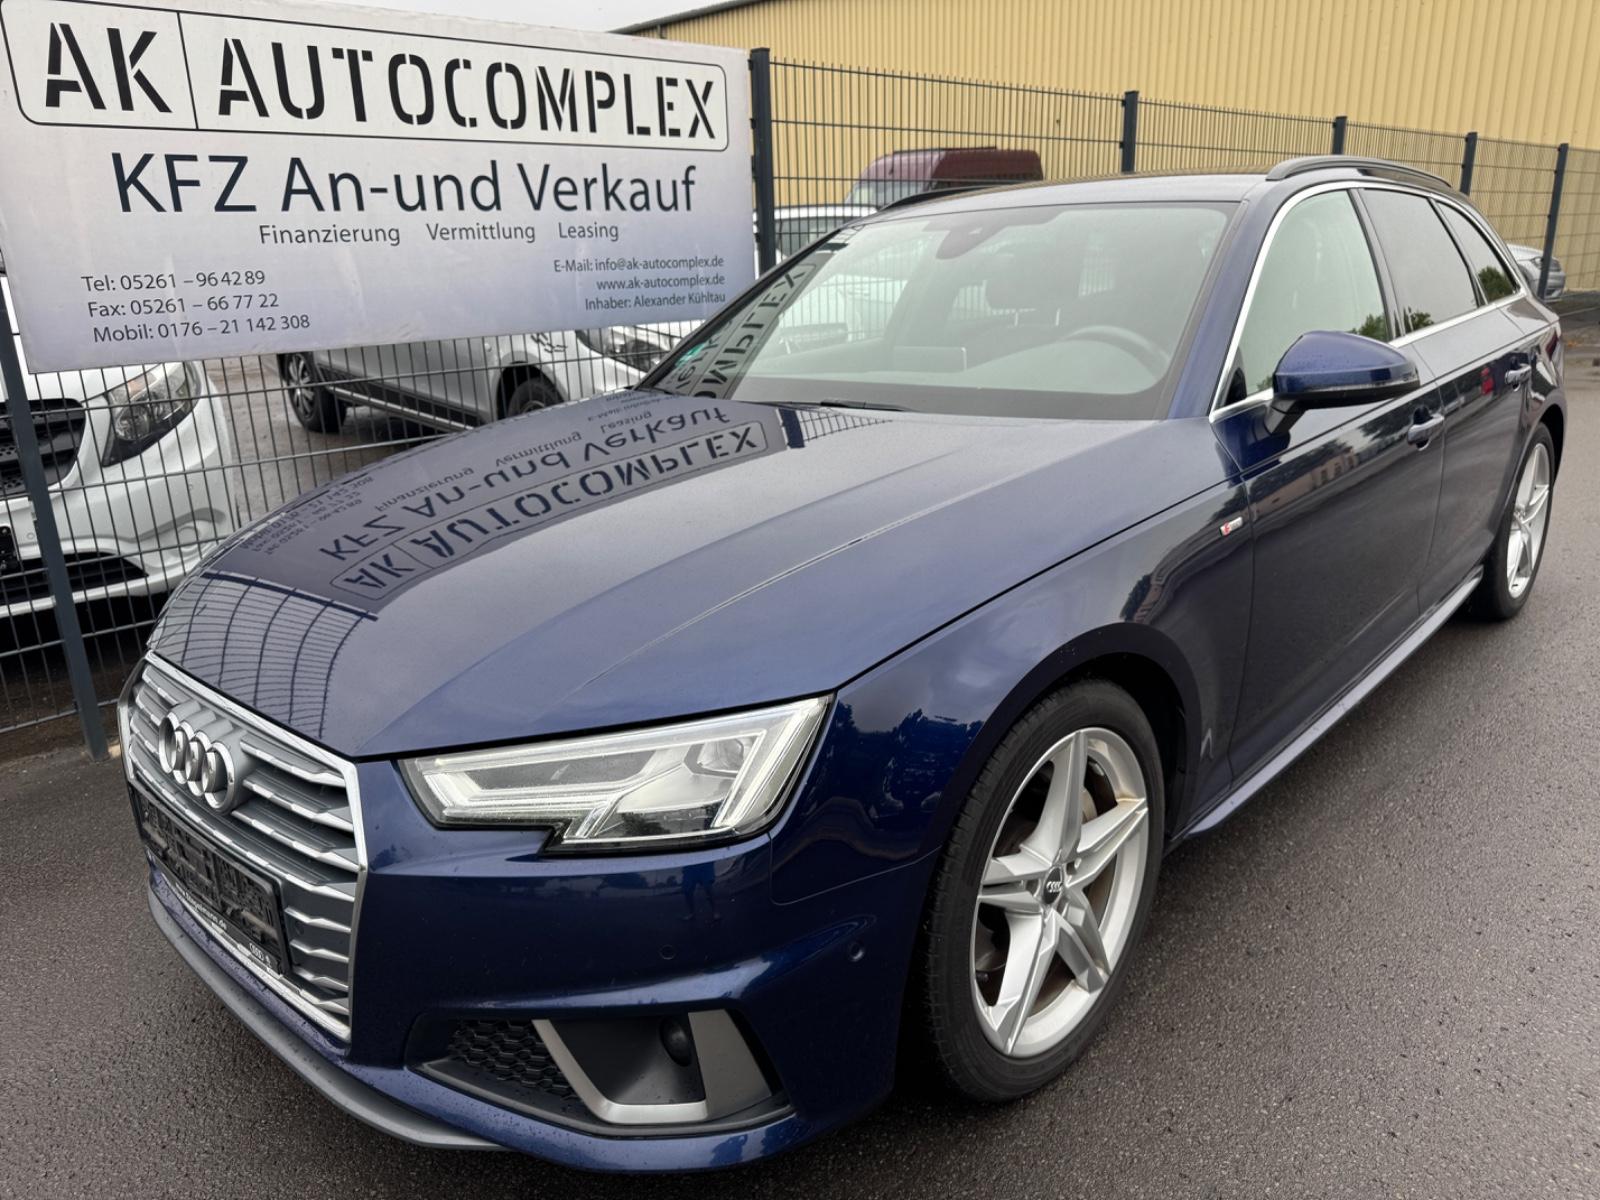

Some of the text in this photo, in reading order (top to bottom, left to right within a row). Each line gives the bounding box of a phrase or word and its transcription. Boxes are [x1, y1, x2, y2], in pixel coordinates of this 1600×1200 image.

[46, 23, 716, 139] AK AUTOCOMPLEX
[111, 152, 697, 213] KFZ An-und Verkauf
[259, 221, 619, 247] Finanzierung Vermittlung Leasing
[553, 255, 724, 273] E-Mail: info@ak-autocomplex.de
[80, 274, 116, 292] Tel:
[120, 273, 176, 291] 05261
[596, 273, 725, 290] www.ak-autocomplex.de
[87, 301, 126, 318] Fax:
[130, 297, 185, 315] 05261
[585, 291, 726, 311] Inhaber: Alexander Kühltau
[93, 323, 154, 343] Mobil:
[157, 321, 203, 339] 0176
[220, 319, 239, 335] 21
[246, 316, 276, 333] 142
[280, 314, 311, 330] 308
